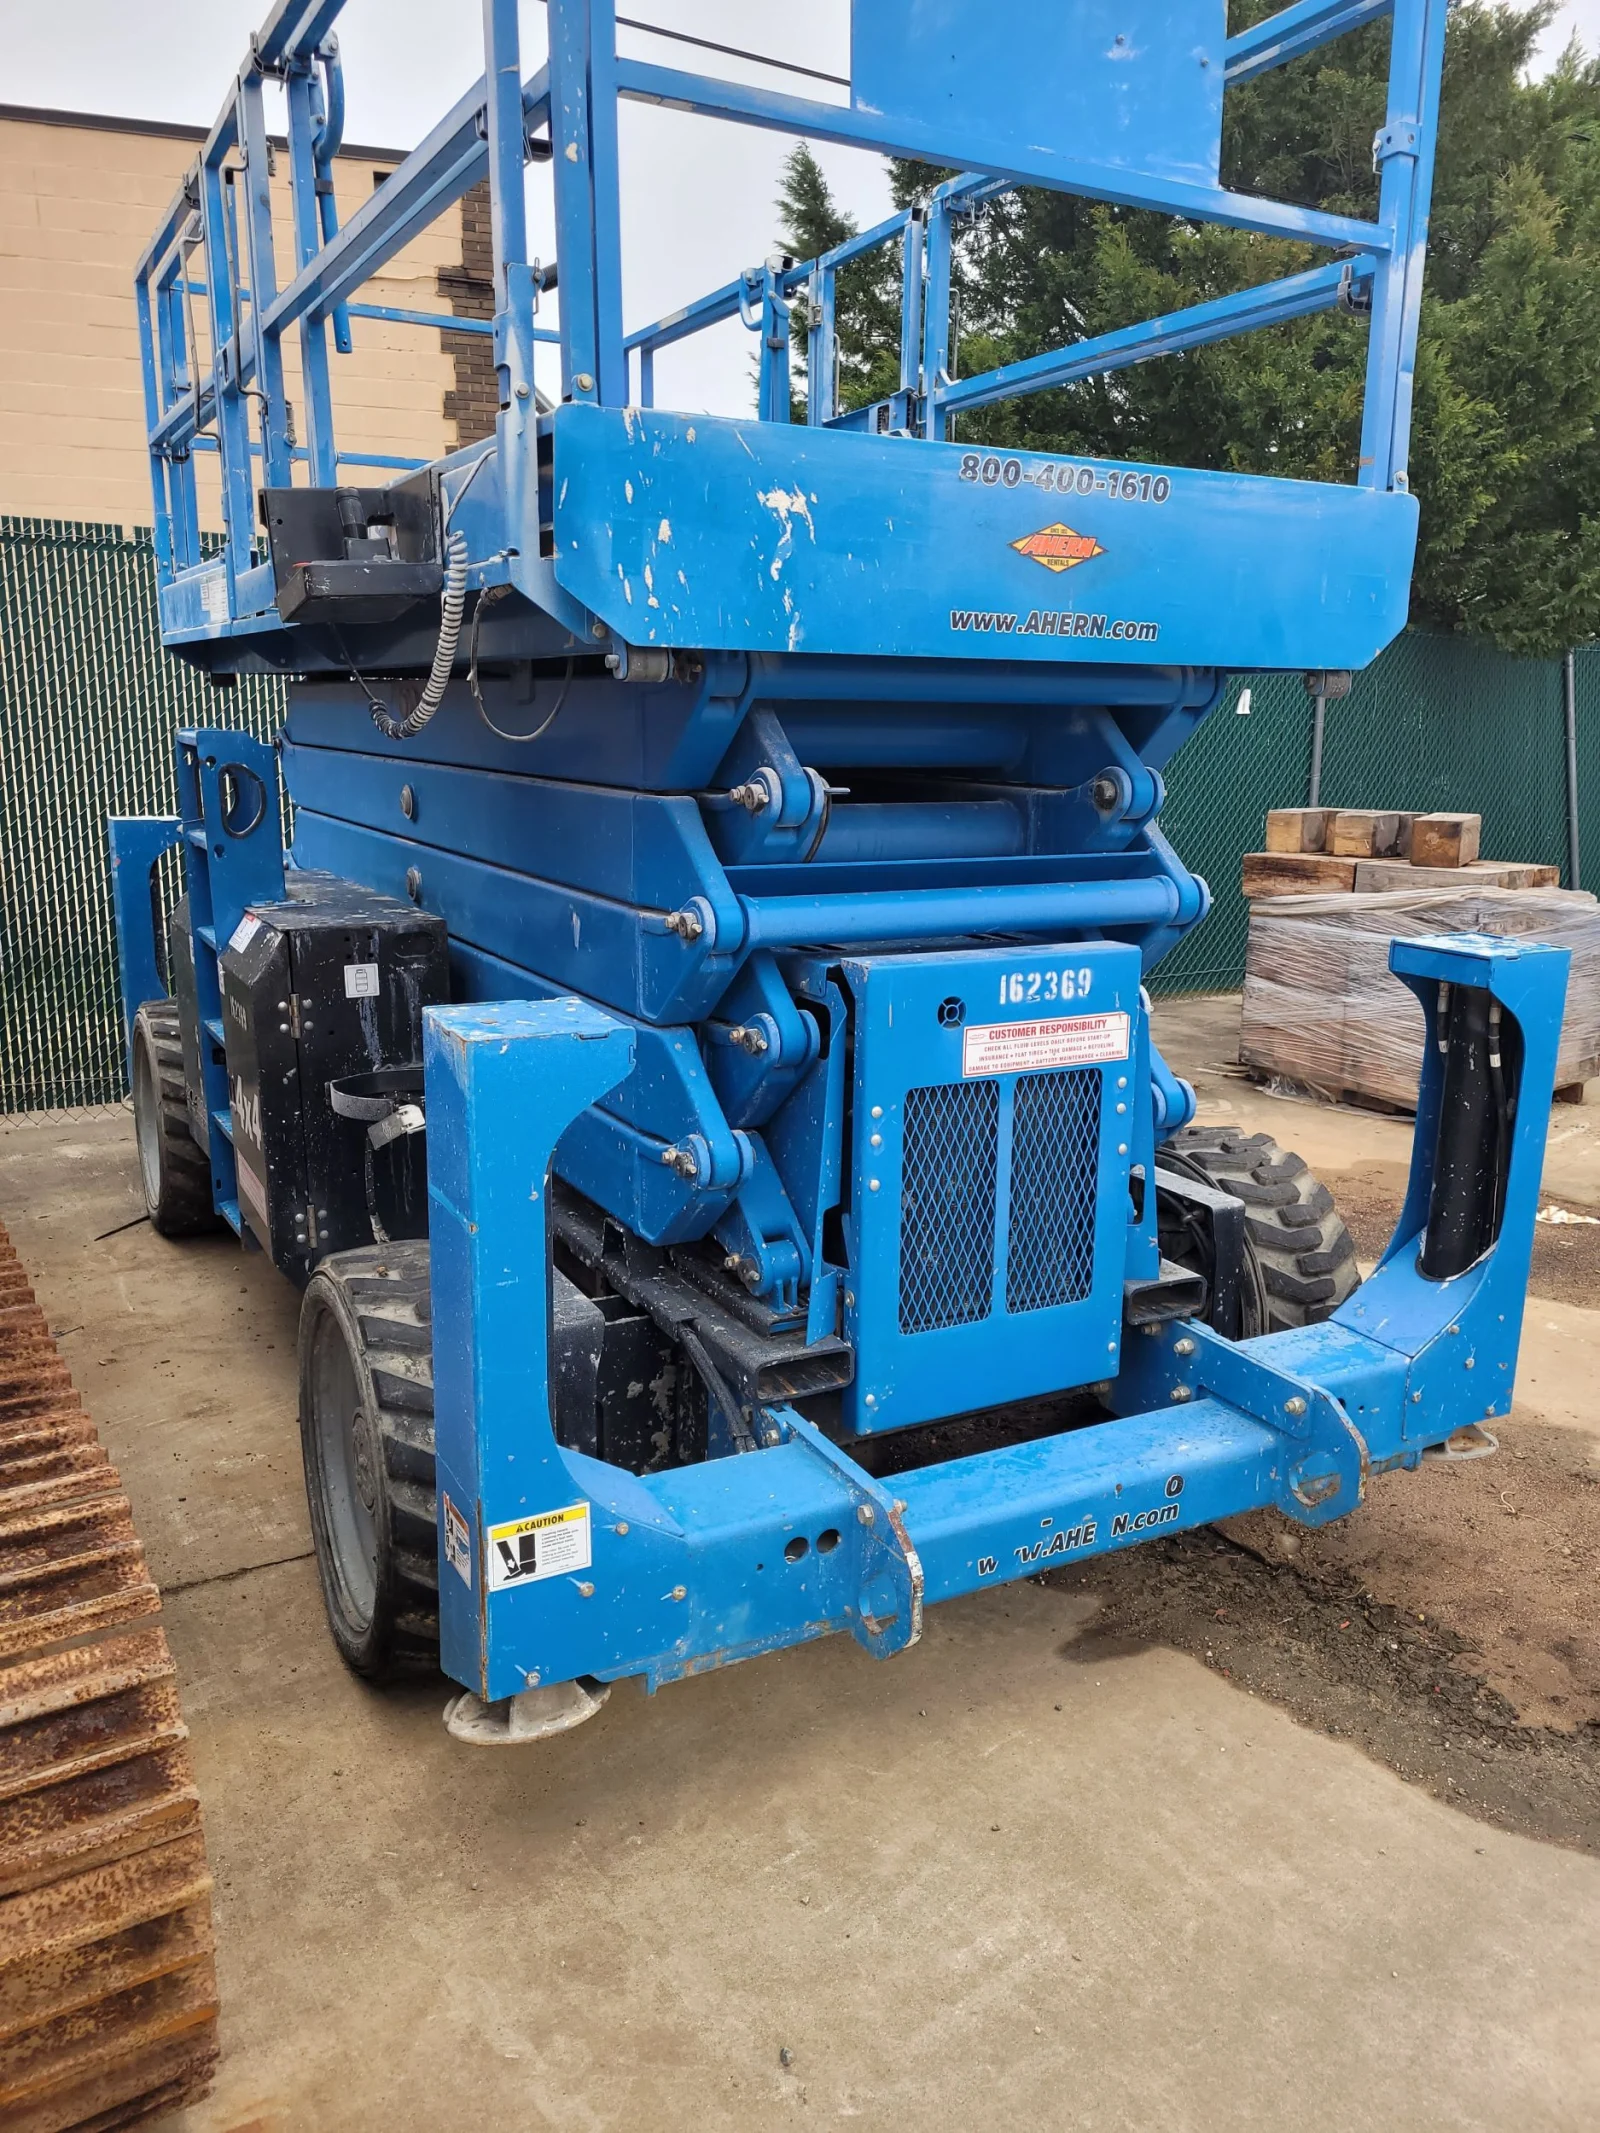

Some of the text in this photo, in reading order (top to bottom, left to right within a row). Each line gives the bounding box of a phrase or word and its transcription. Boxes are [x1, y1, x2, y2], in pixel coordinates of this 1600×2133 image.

[959, 453, 1170, 503] 800-400-1610
[1020, 534, 1097, 558] AHERN
[1047, 558, 1069, 567] RENTALS
[950, 609, 1159, 641] www.AHERN.com
[1000, 967, 1092, 1005] 162369
[989, 1019, 1107, 1040] CUSTOMER RESPONSIBILITY
[984, 1044, 1001, 1052] CHECK
[1030, 1040, 1049, 1048] LEVELS
[1087, 1033, 1111, 1041] START-UP
[978, 1053, 1009, 1062] INSURANCE
[1028, 1049, 1043, 1057] TIRES
[1061, 1045, 1082, 1053] DAMAGE
[524, 1513, 564, 1531] CAUTION
